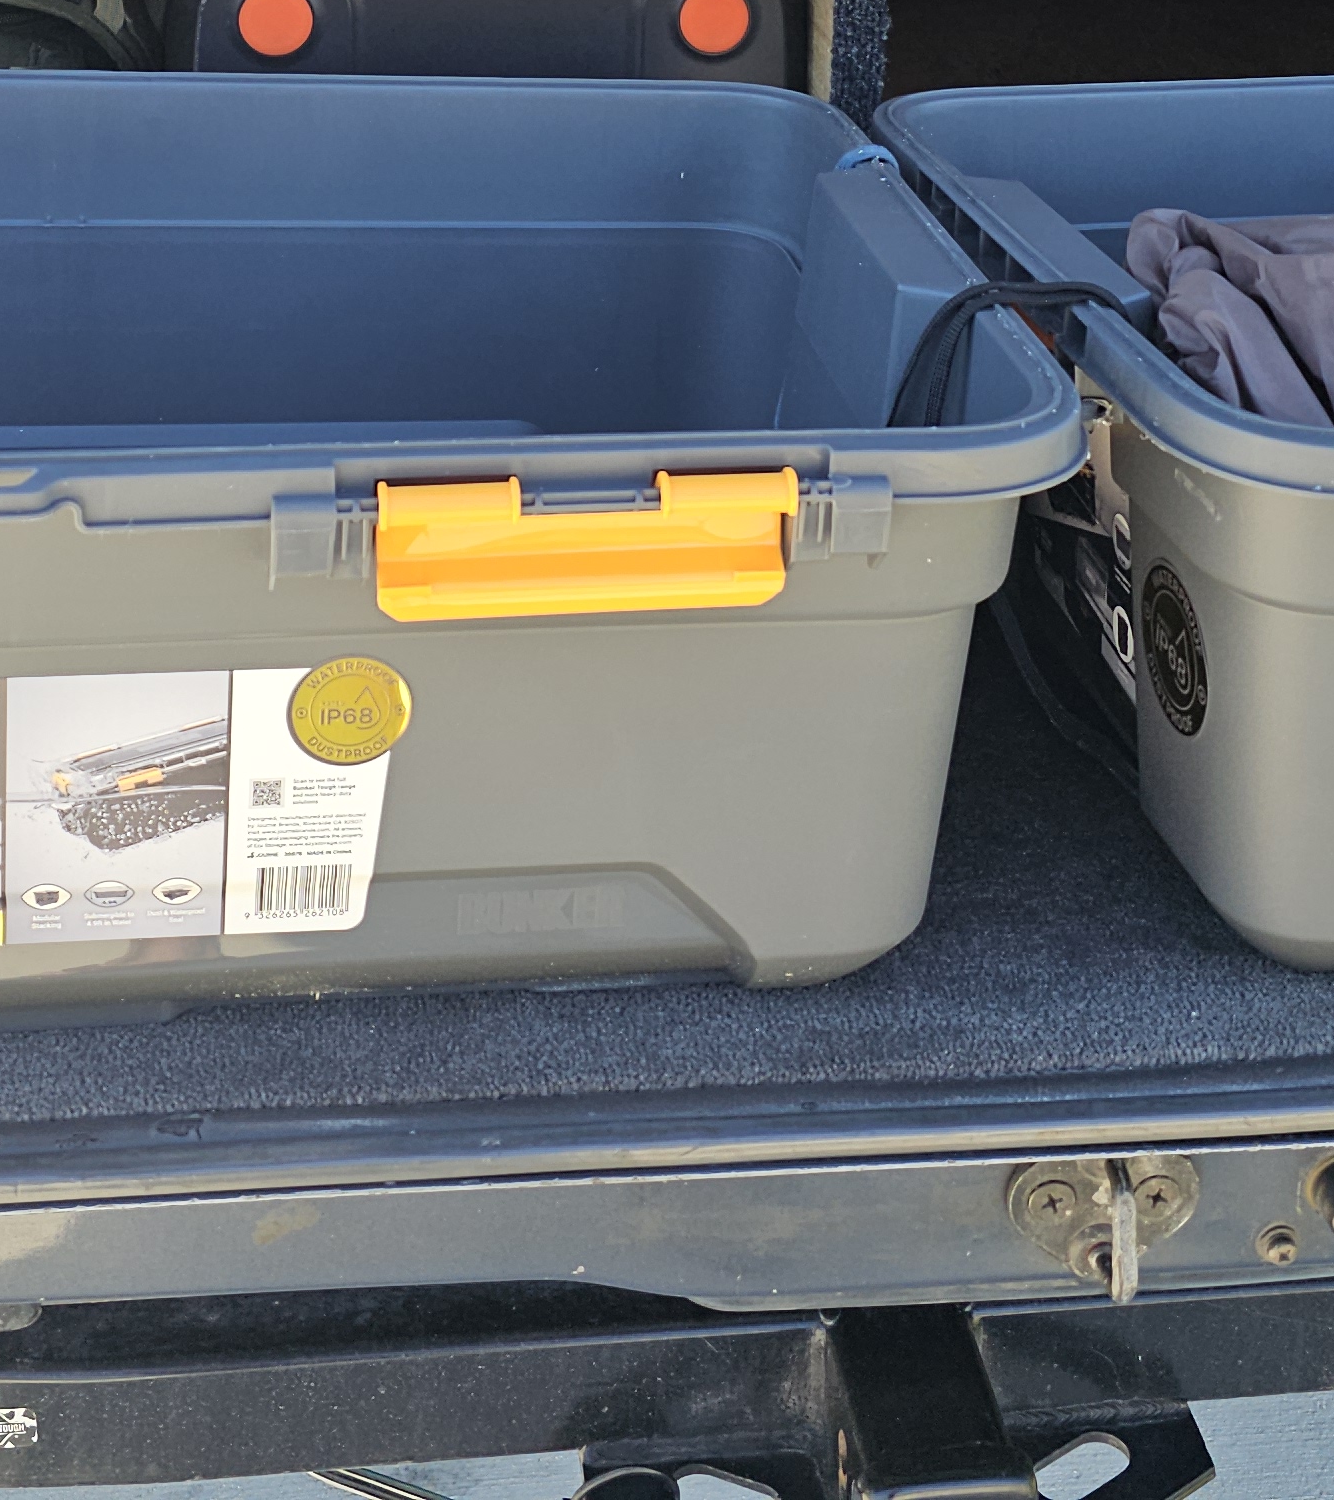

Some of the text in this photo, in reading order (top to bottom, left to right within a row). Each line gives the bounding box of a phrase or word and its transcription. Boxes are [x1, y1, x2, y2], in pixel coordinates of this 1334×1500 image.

[306, 660, 398, 690] WATERPROOF
[320, 707, 374, 726] IP68
[307, 735, 389, 760] DUSTPROOF
[257, 909, 299, 920] 326265
[304, 907, 346, 918] 262108
